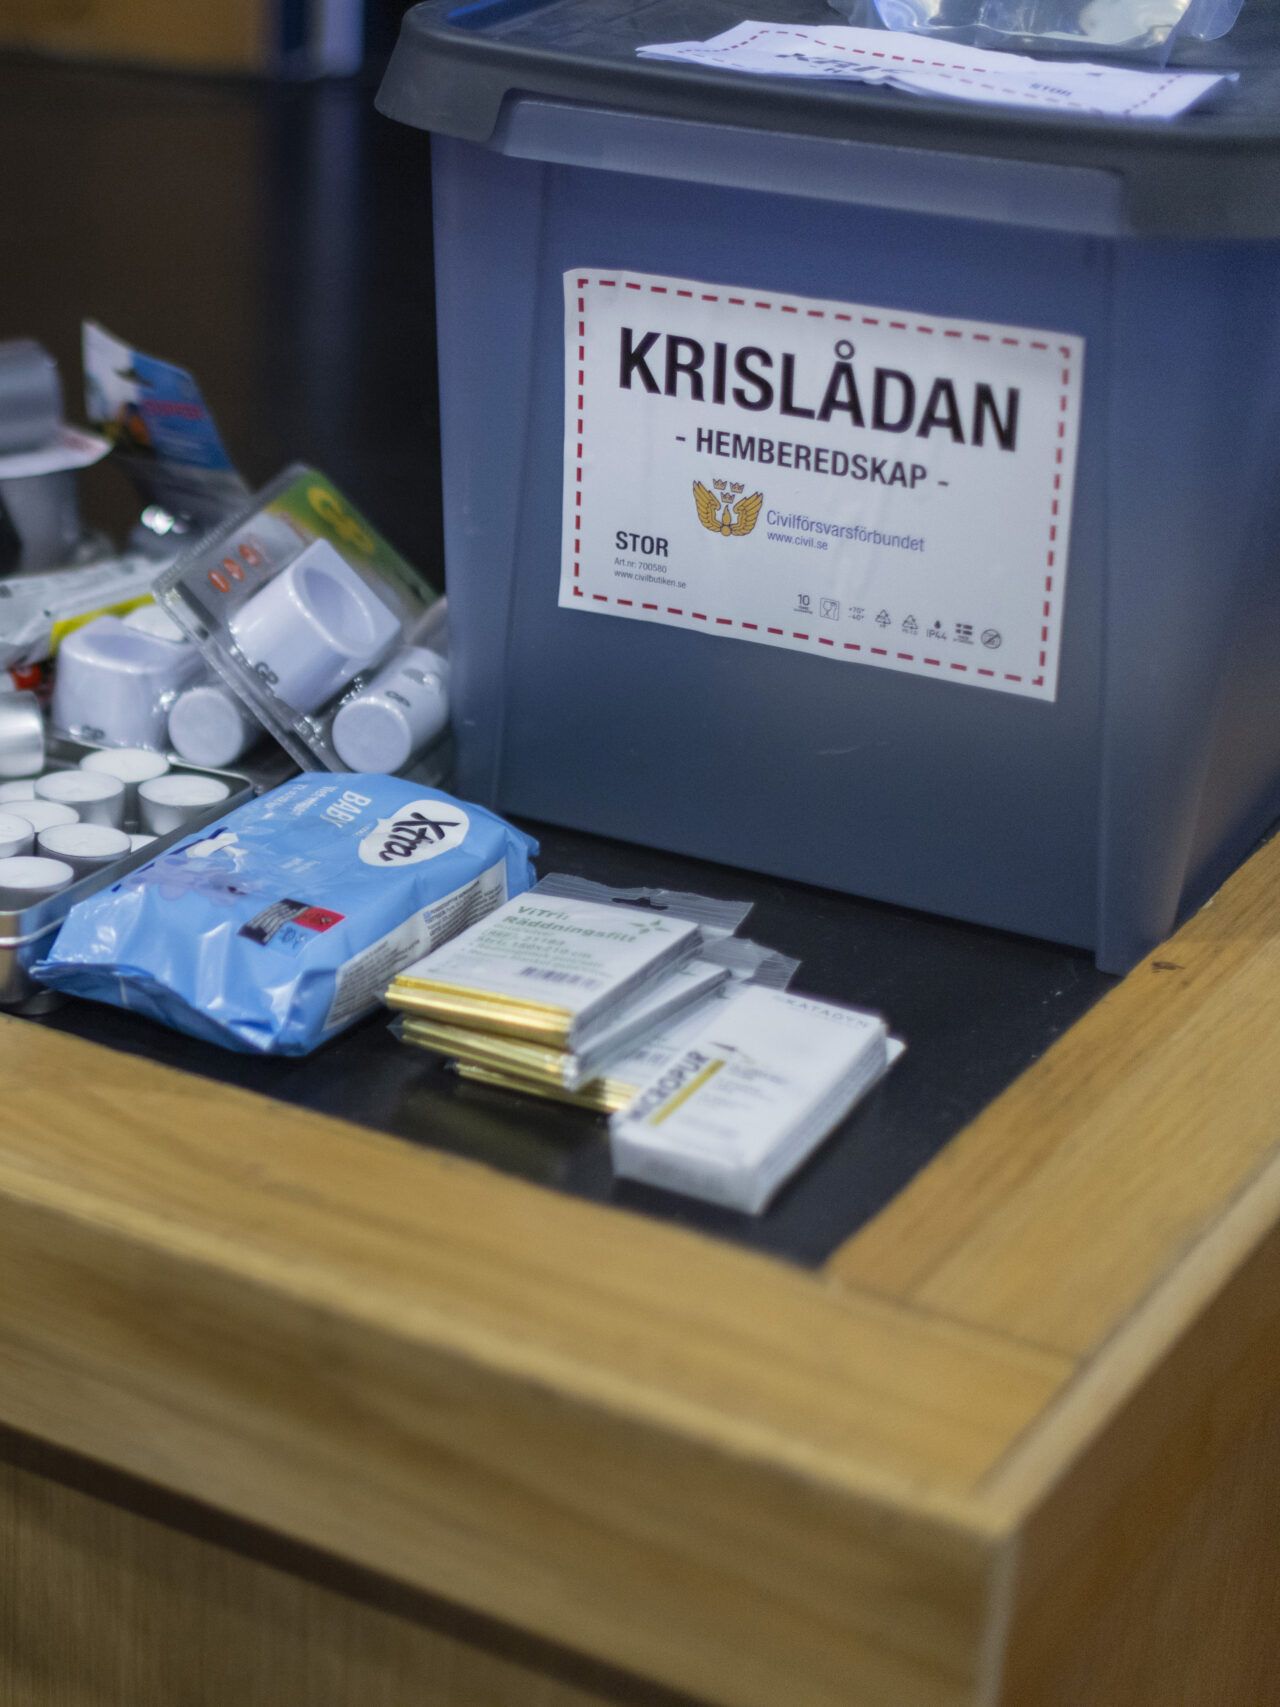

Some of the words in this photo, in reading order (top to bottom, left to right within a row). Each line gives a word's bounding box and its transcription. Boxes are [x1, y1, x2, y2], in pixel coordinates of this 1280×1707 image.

[619, 325, 1020, 453] KRISLÅDAN
[696, 428, 928, 490] HEMBEREDSKAP
[616, 530, 669, 557] STOR
[766, 510, 925, 552] Civilförsvarsförbundet
[767, 531, 828, 551] www.civil.se
[613, 569, 687, 589] www.civilbutiken.se
[797, 594, 810, 606] 10
[926, 629, 947, 641] IP44
[320, 788, 372, 829] BABY
[380, 811, 460, 863] Xtra
